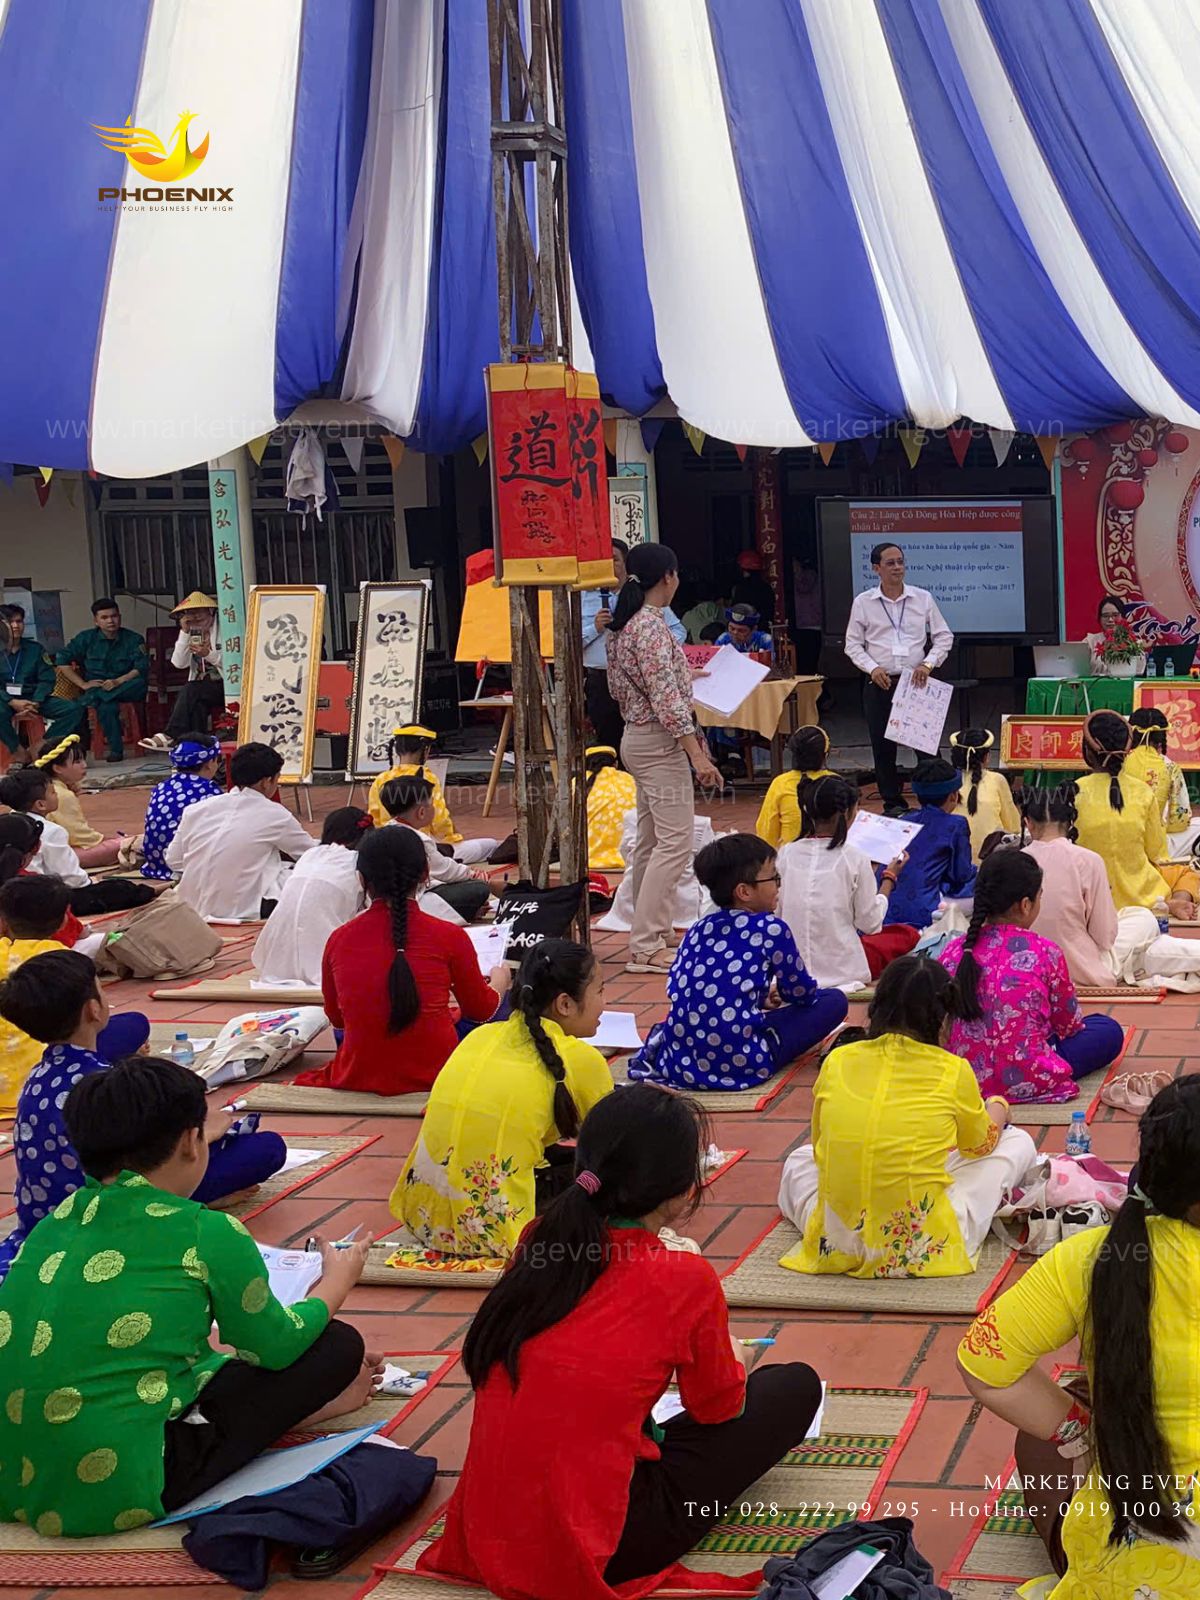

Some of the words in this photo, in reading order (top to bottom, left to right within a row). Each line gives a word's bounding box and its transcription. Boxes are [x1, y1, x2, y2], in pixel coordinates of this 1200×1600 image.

[500, 410, 572, 488] 道
[509, 901, 540, 915] LIFE
[506, 932, 545, 949] SAGE
